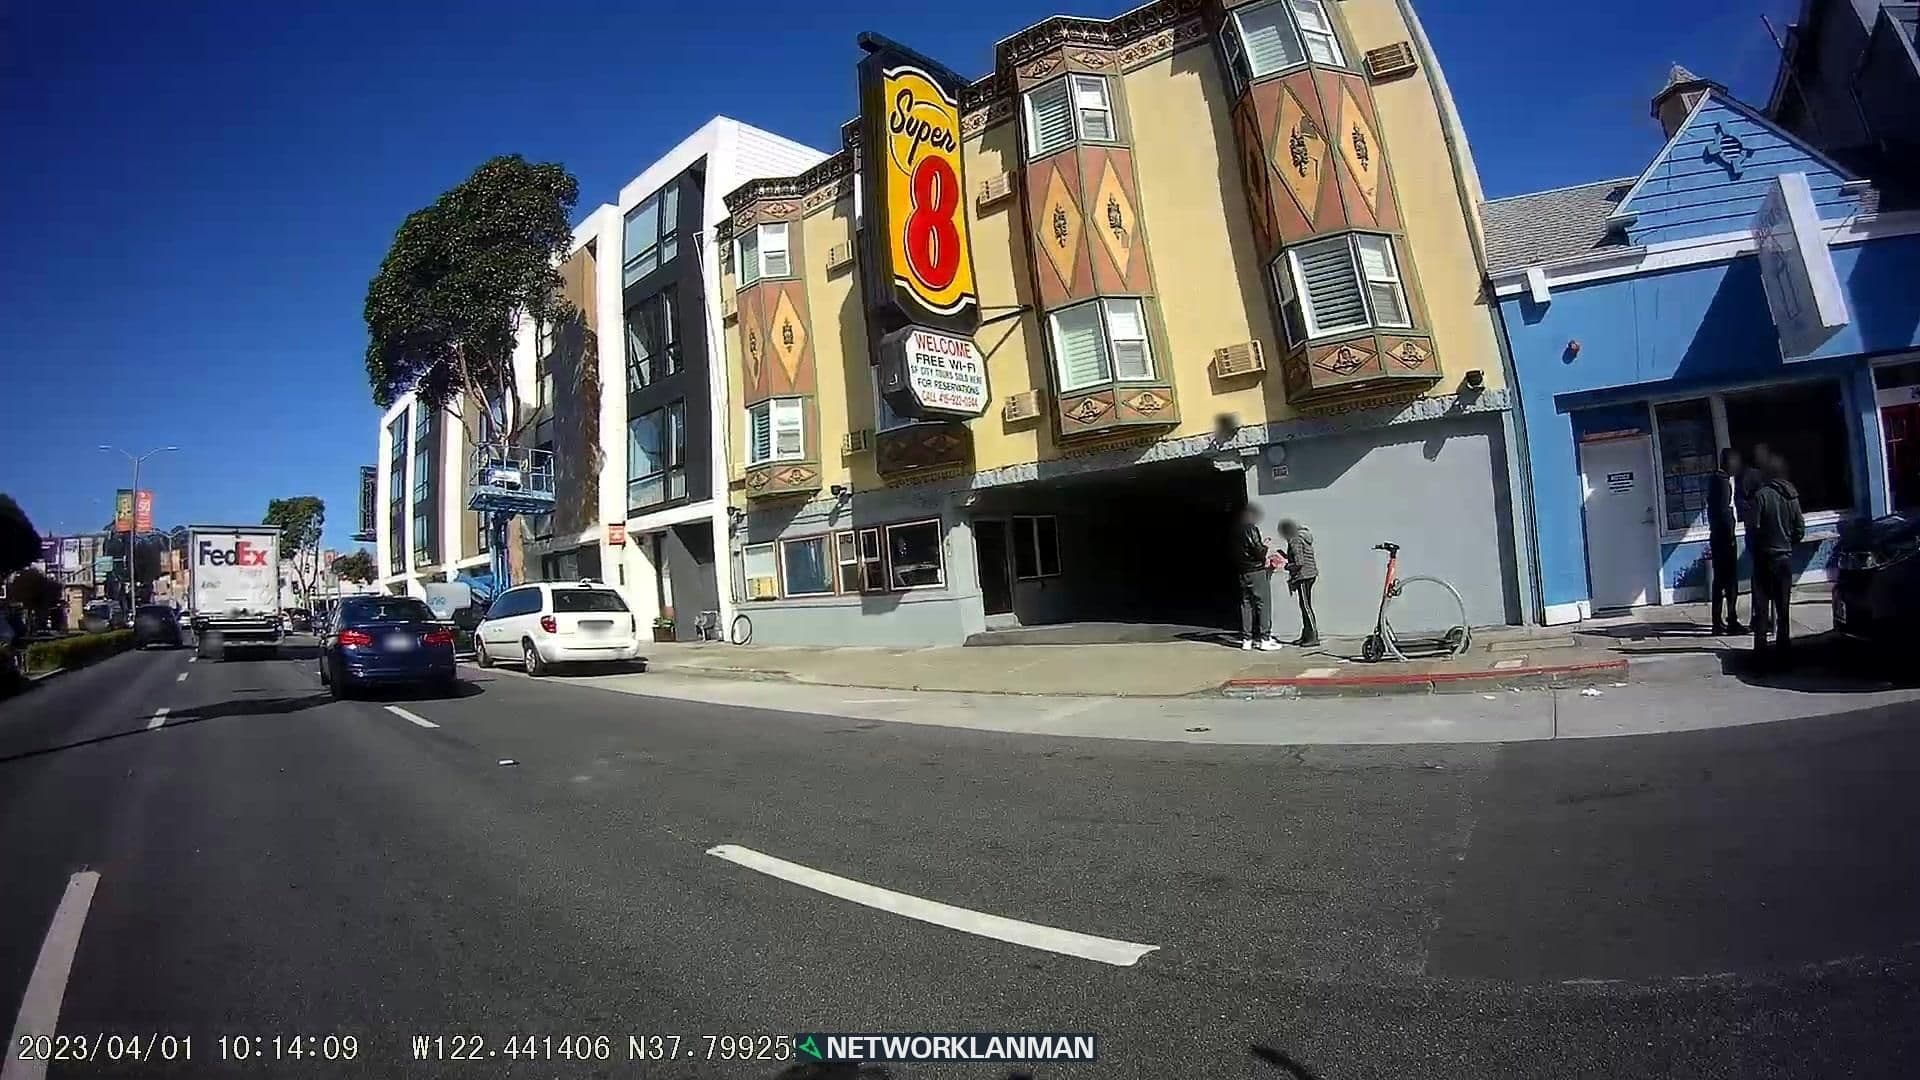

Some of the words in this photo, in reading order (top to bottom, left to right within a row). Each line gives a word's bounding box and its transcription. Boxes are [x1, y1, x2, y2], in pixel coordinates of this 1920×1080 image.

[890, 89, 956, 166] Super
[904, 154, 960, 291] 8
[914, 333, 972, 359] WELCOME
[916, 353, 945, 367] FREE
[949, 359, 976, 373] WI-FI
[921, 366, 933, 377] CITY
[955, 372, 969, 383] SOLD
[917, 378, 932, 389] FOR
[934, 379, 980, 396] RESERVATIONS
[921, 390, 937, 403] CALL
[199, 541, 268, 566] FedEx
